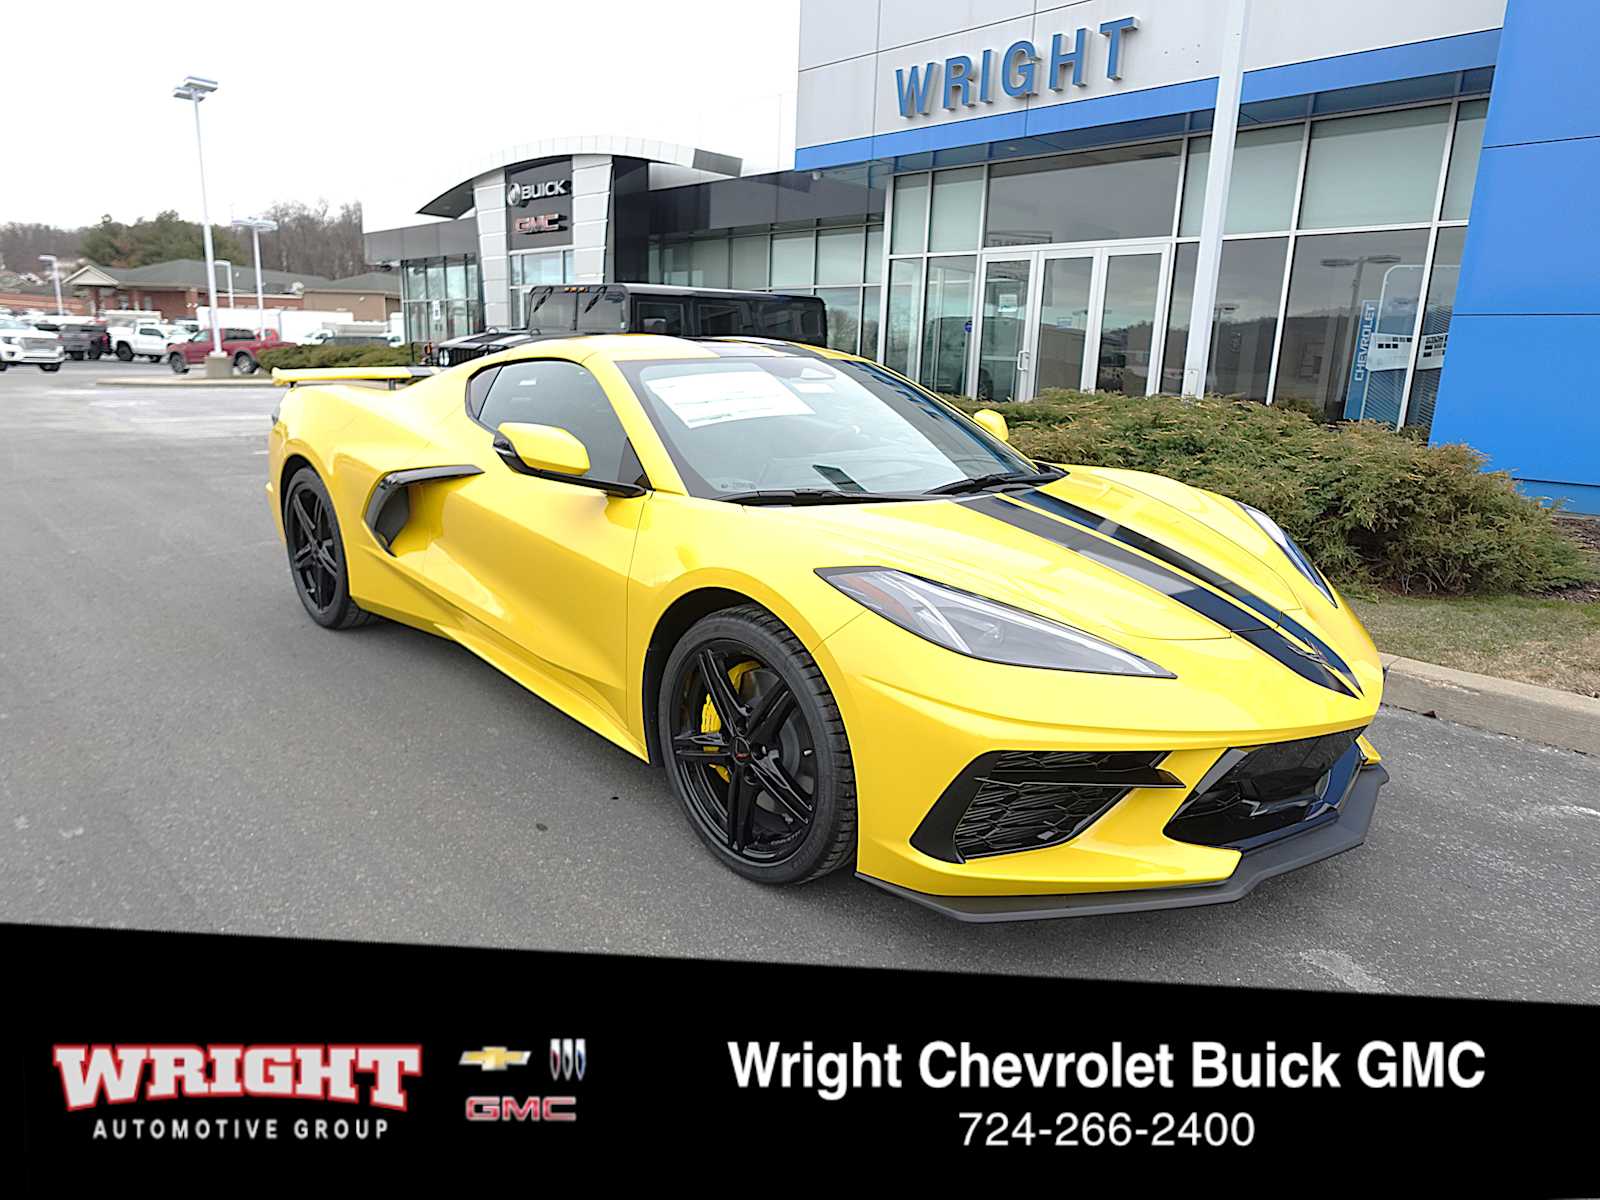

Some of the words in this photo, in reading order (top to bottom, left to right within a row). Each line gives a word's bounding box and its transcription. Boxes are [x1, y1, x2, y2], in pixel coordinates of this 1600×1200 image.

[895, 16, 1141, 119] WRIGHT
[521, 180, 567, 200] BUICK
[514, 213, 559, 234] GMC
[1354, 304, 1376, 381] CHEVROLET
